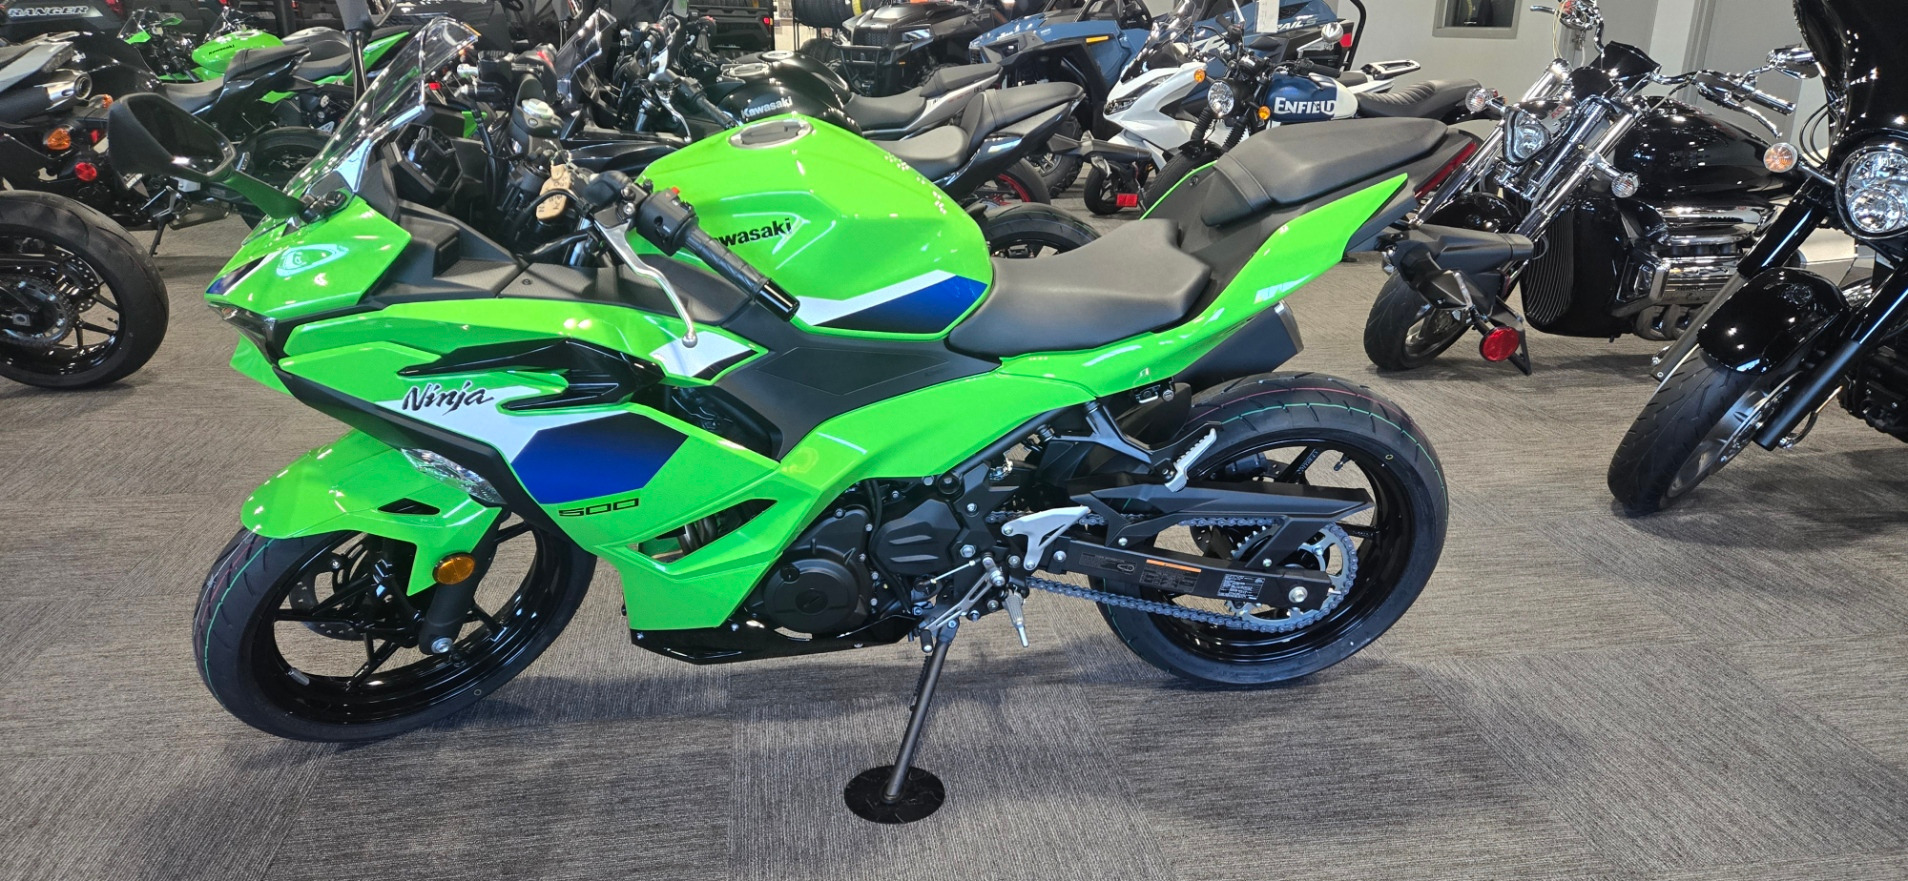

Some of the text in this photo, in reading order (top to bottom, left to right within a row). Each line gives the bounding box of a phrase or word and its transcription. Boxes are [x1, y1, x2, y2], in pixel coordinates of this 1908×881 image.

[7, 6, 90, 18] RANGER
[740, 95, 793, 119] Kawasaki
[1273, 96, 1336, 115] ENFIELD
[402, 381, 494, 416] Ninja
[558, 498, 639, 516] 500
